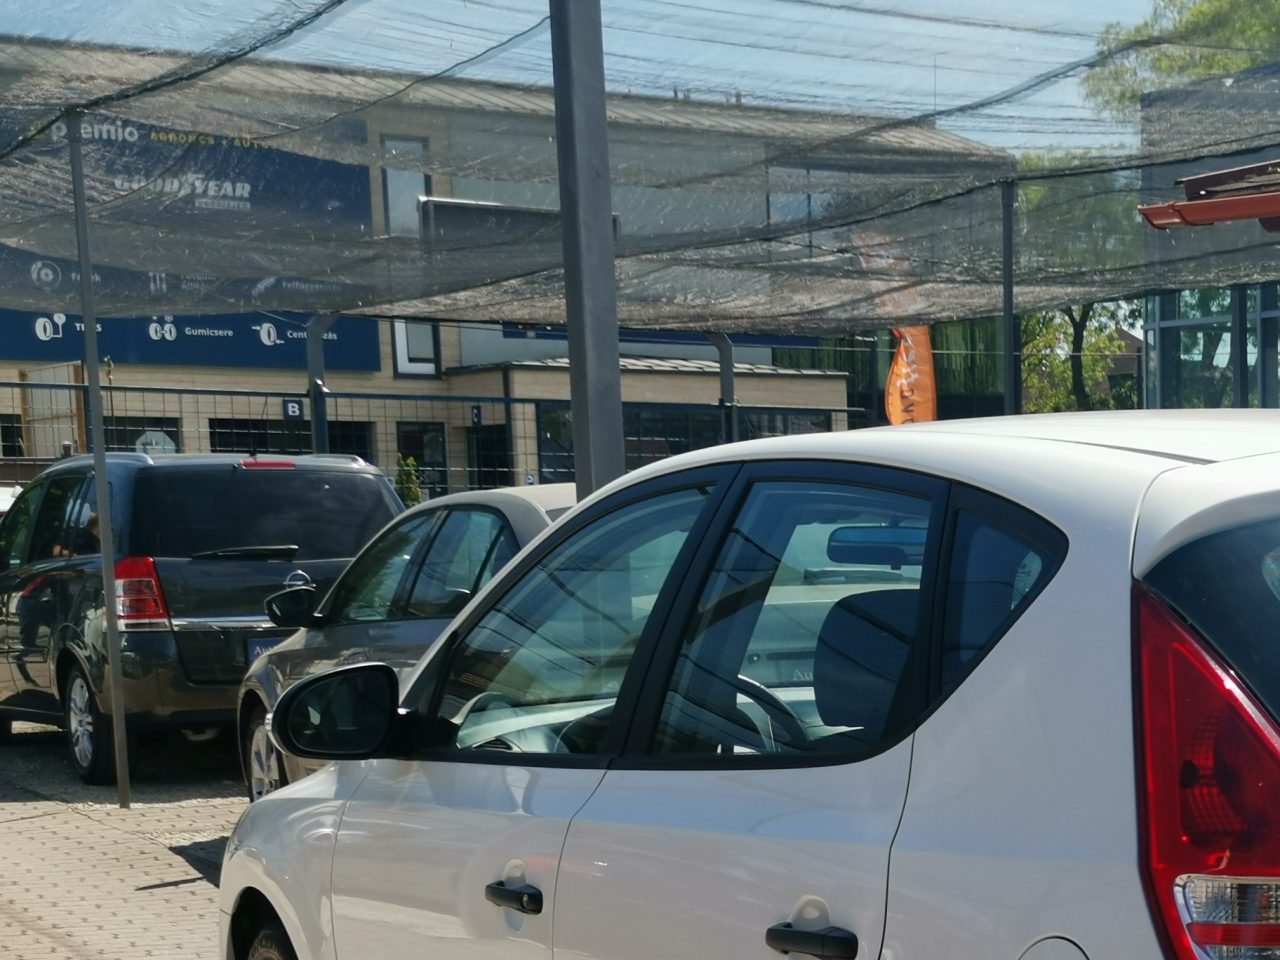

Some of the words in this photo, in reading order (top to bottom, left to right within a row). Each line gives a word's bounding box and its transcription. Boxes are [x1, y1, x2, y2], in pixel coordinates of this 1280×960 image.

[52, 119, 139, 144] pemio
[184, 327, 234, 337] Gumicsere
[287, 403, 300, 416] B
